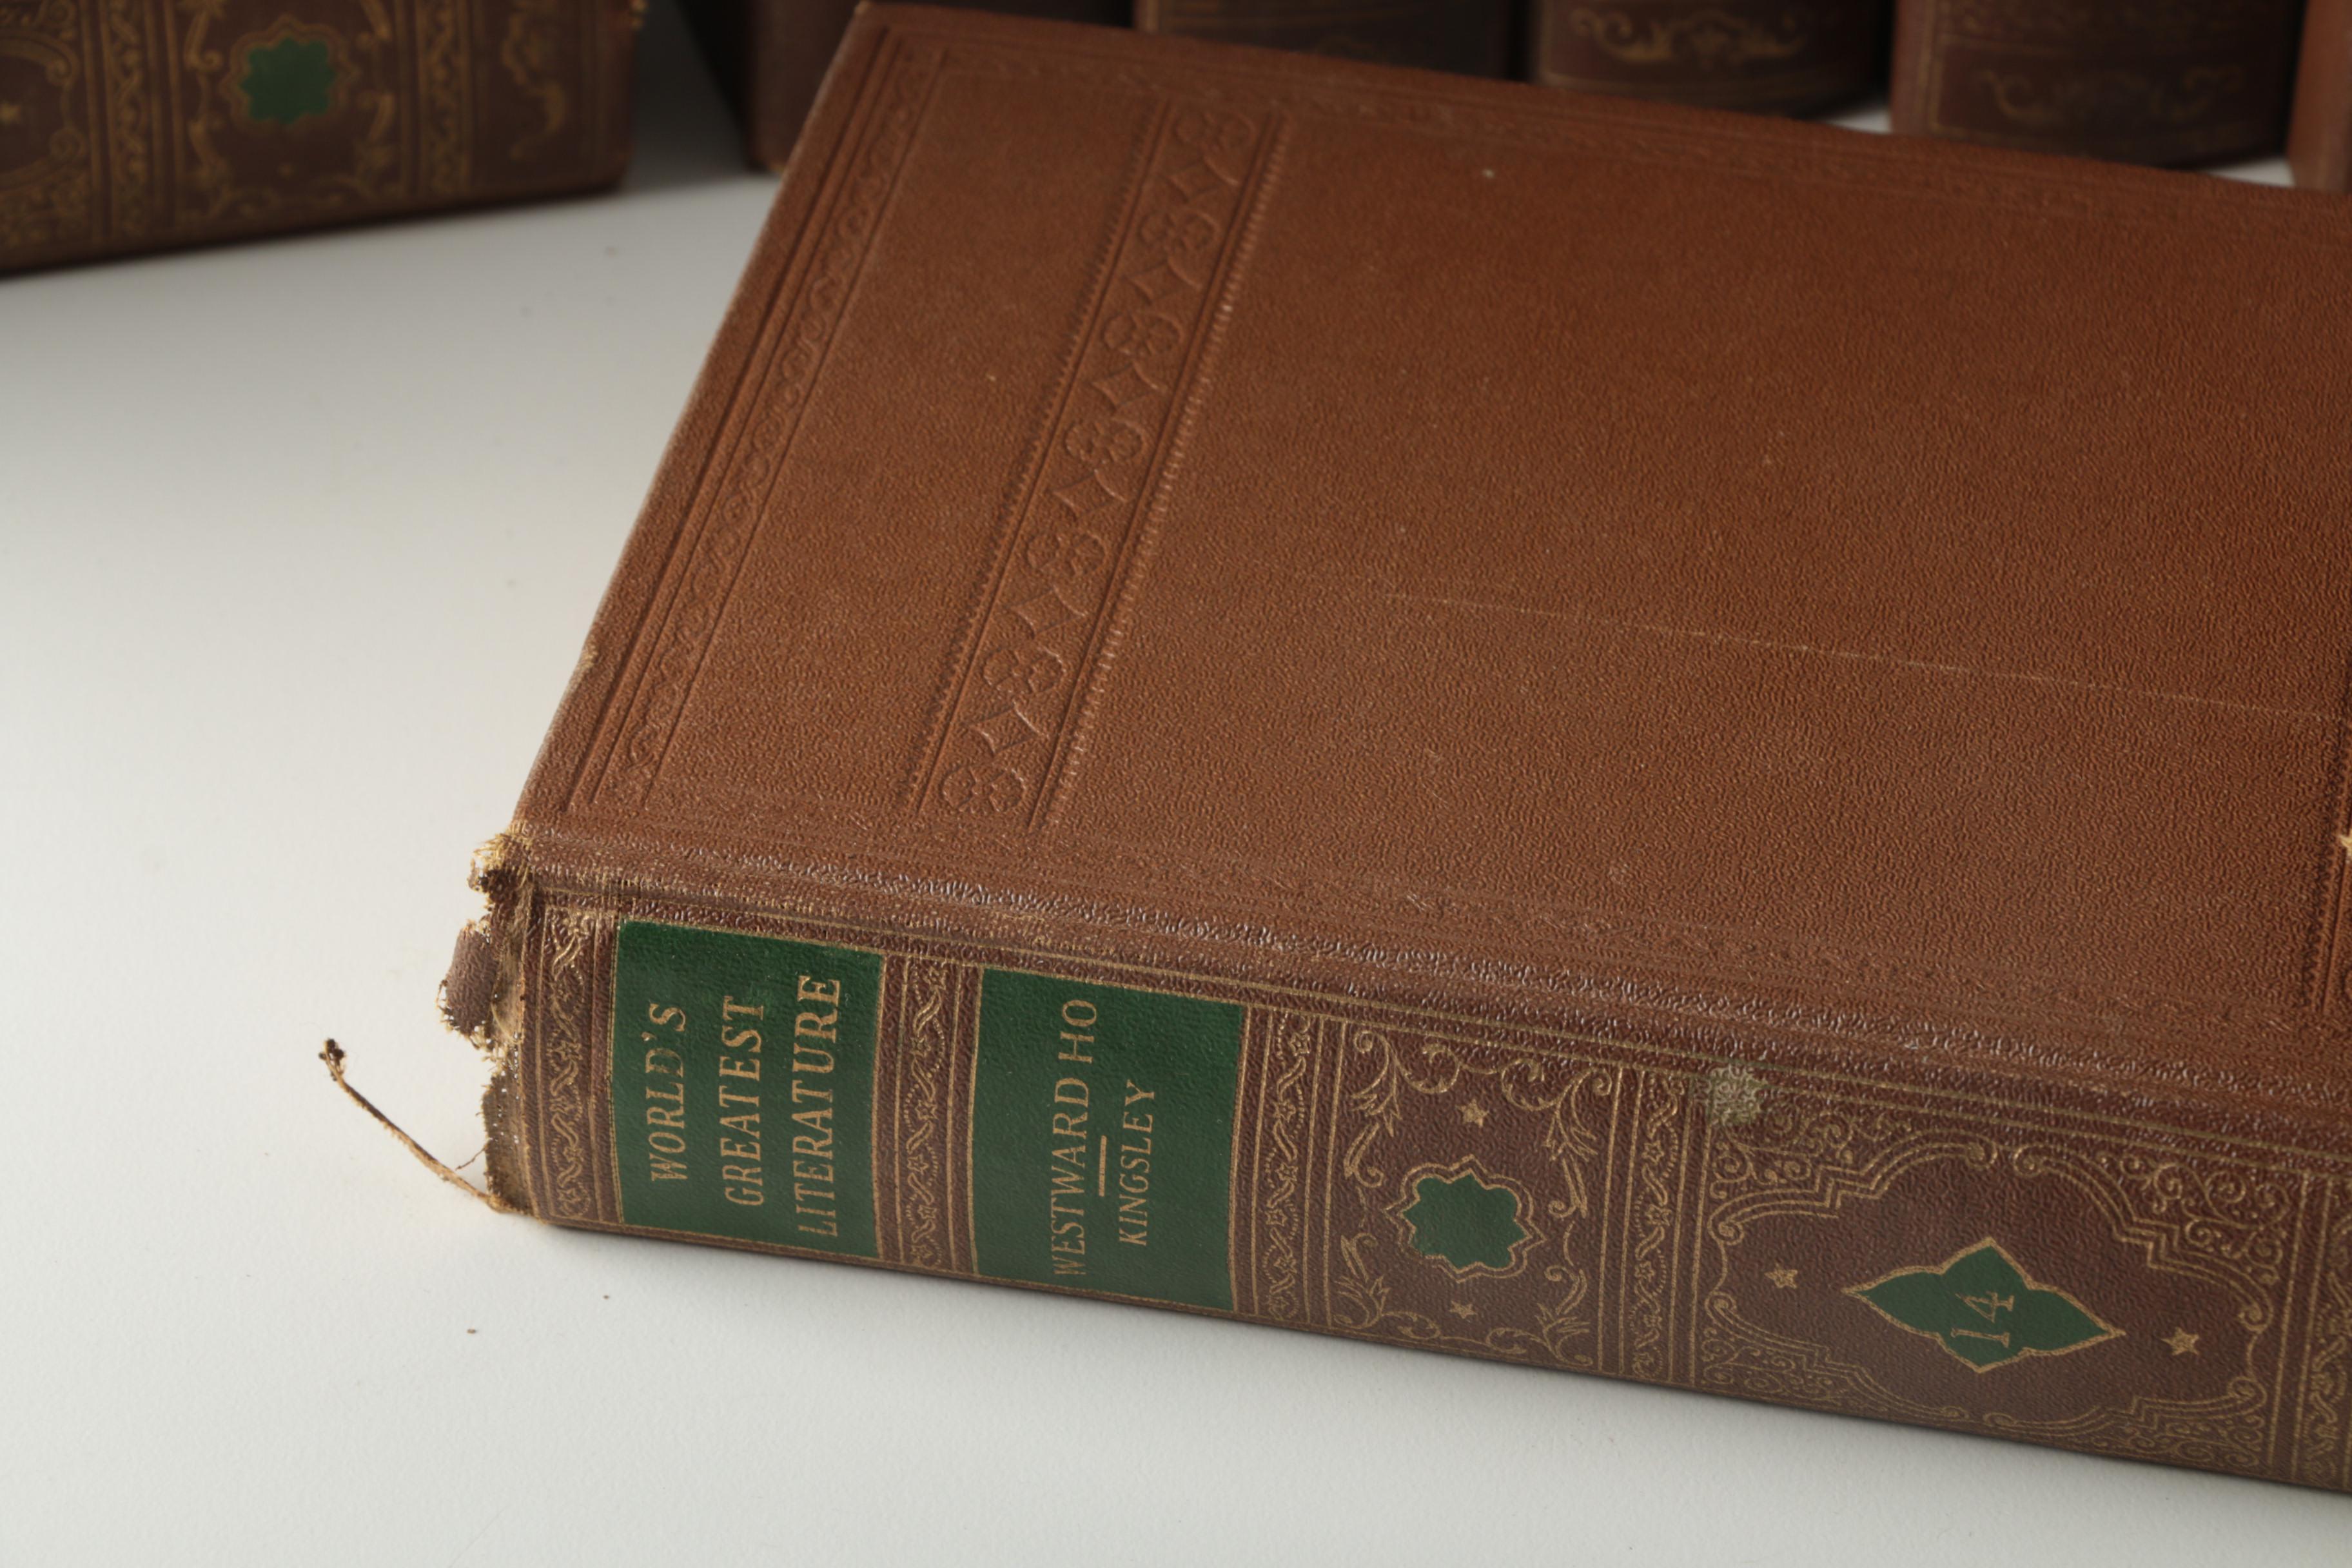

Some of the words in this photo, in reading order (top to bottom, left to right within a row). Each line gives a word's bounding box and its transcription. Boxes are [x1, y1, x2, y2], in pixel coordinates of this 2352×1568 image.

[641, 1003, 688, 1182] WORLD'S
[718, 995, 765, 1207] GREATEST
[792, 974, 840, 1238] LITERATURE
[1057, 999, 1097, 1064] HO
[1051, 1077, 1090, 1276] WESTWARD
[1119, 1079, 1155, 1246] KINGSLEY
[1950, 1291, 2015, 1348] 14
